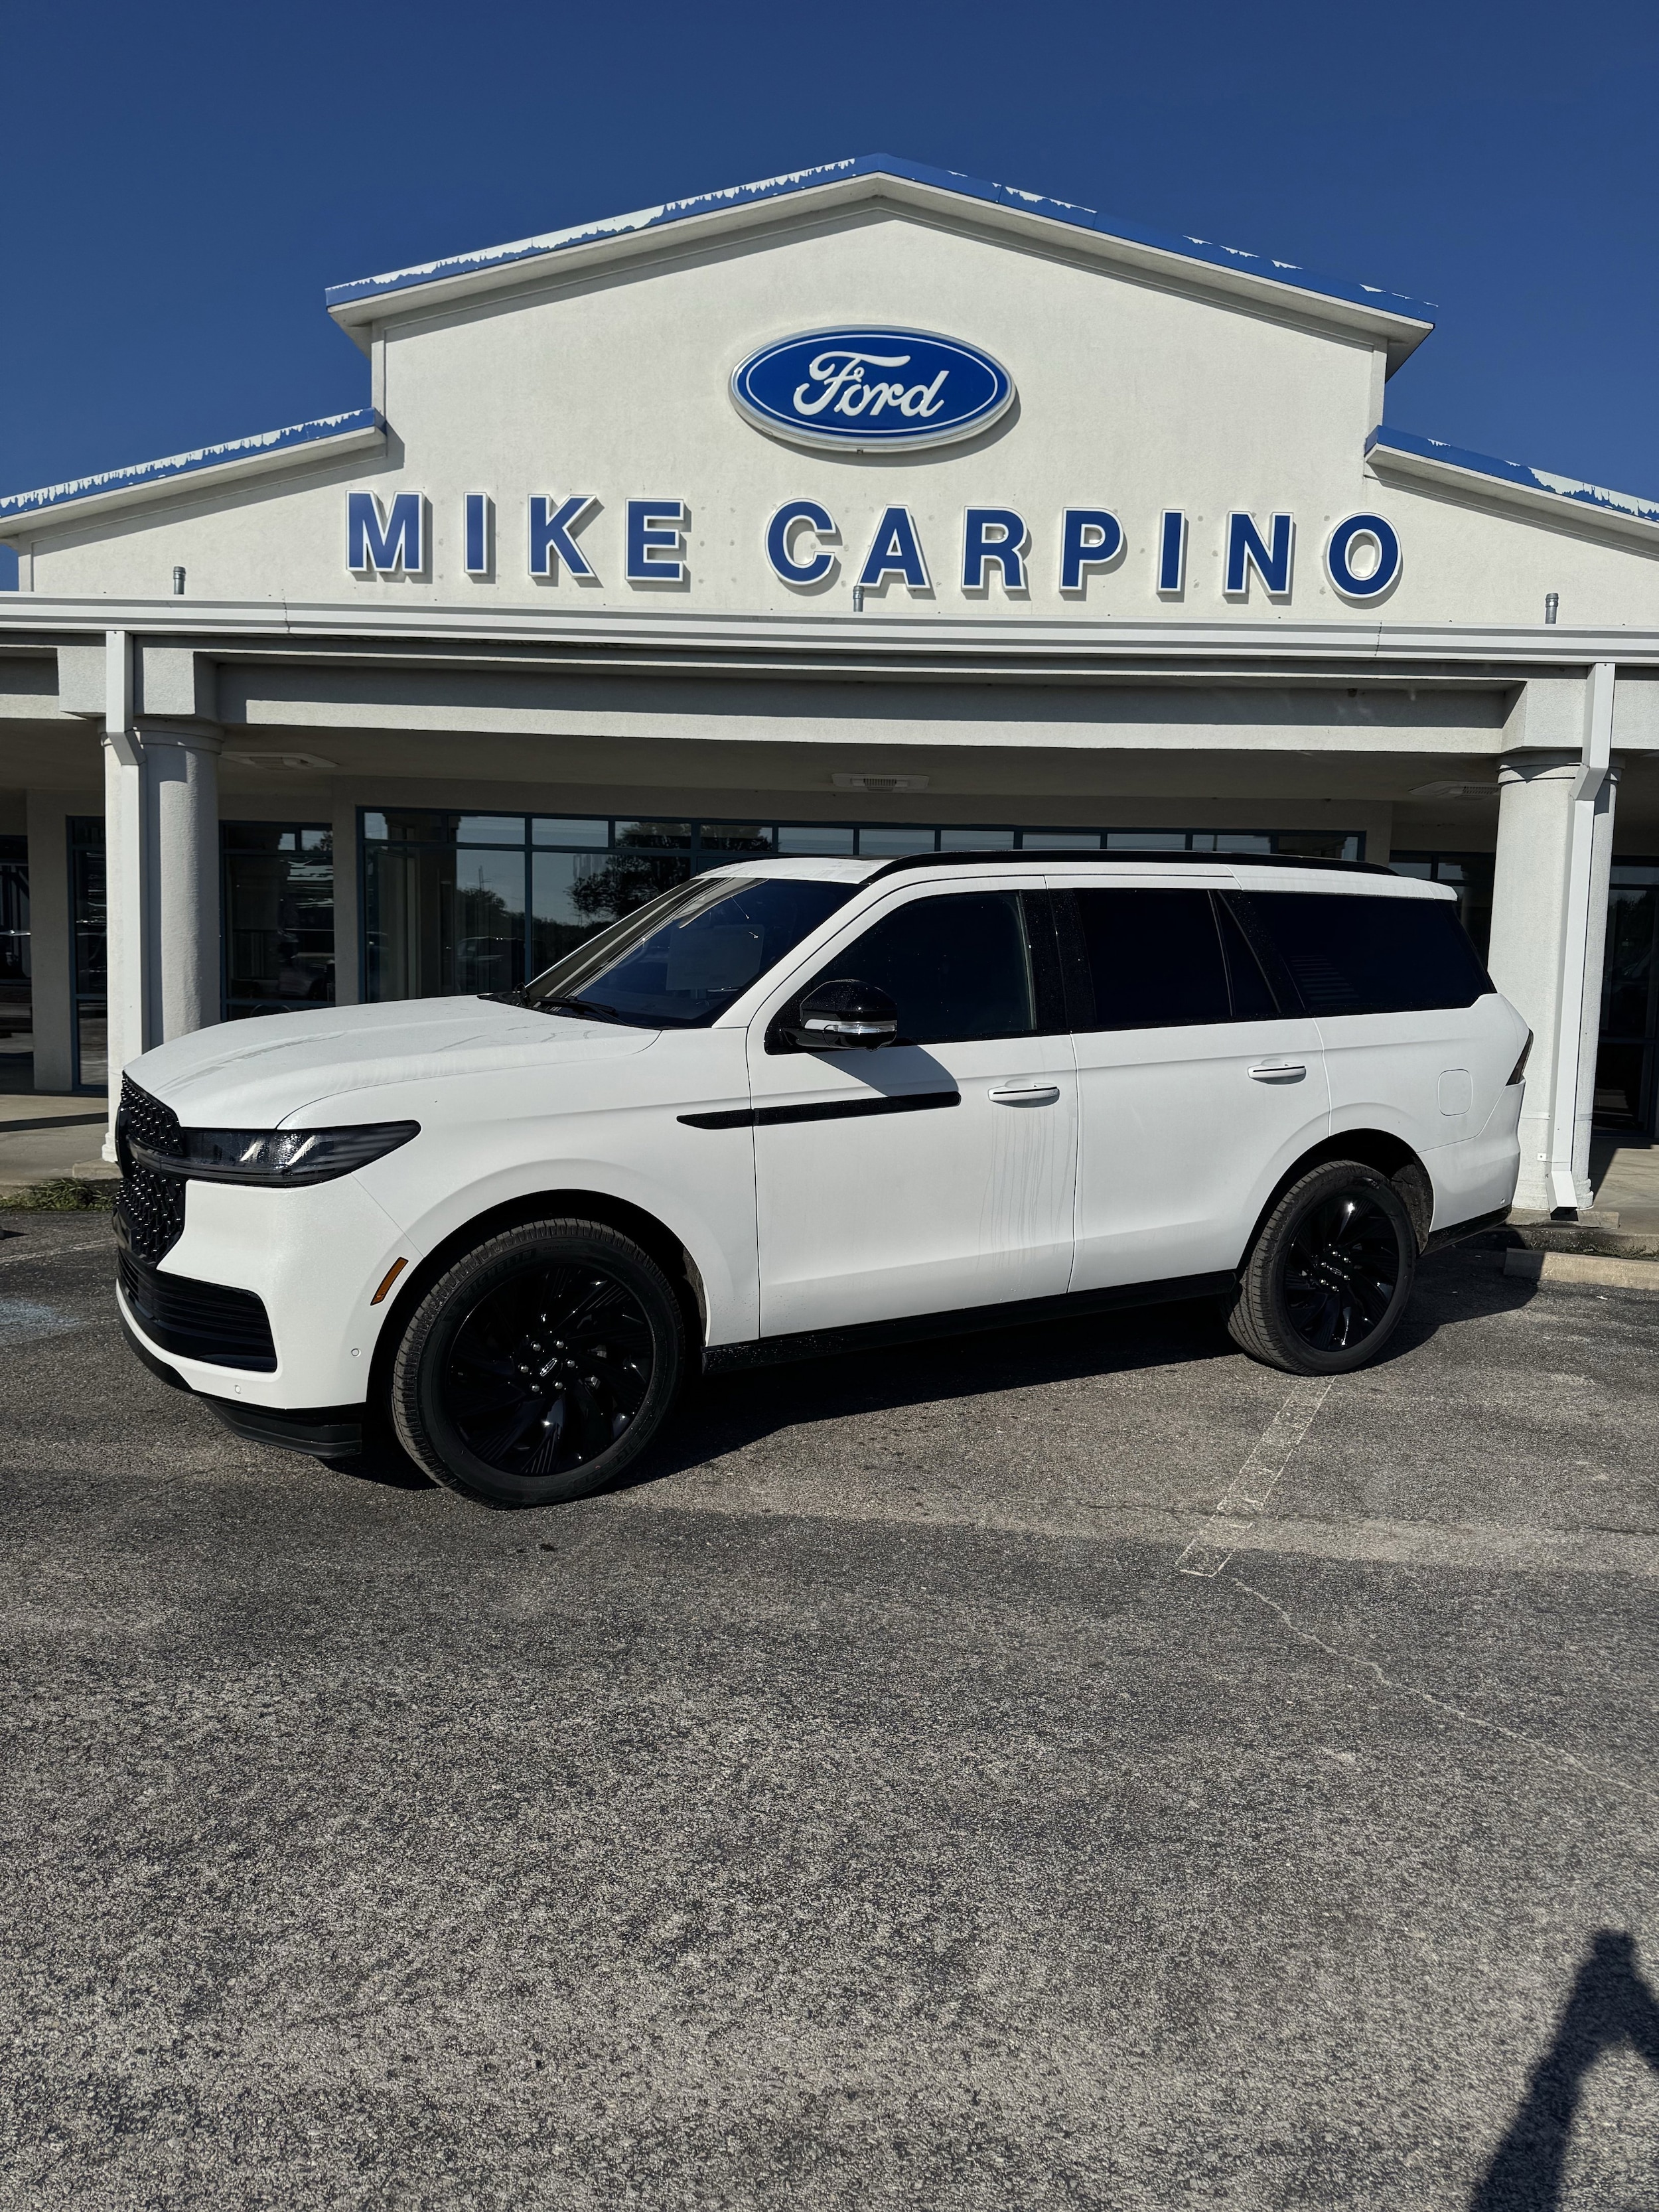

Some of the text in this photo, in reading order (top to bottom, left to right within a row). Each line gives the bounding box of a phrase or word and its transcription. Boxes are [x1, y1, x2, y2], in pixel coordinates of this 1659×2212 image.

[793, 351, 950, 417] Ford
[346, 490, 1402, 601] MIKE CARPINO
[461, 1250, 533, 1301] MICHELIN
